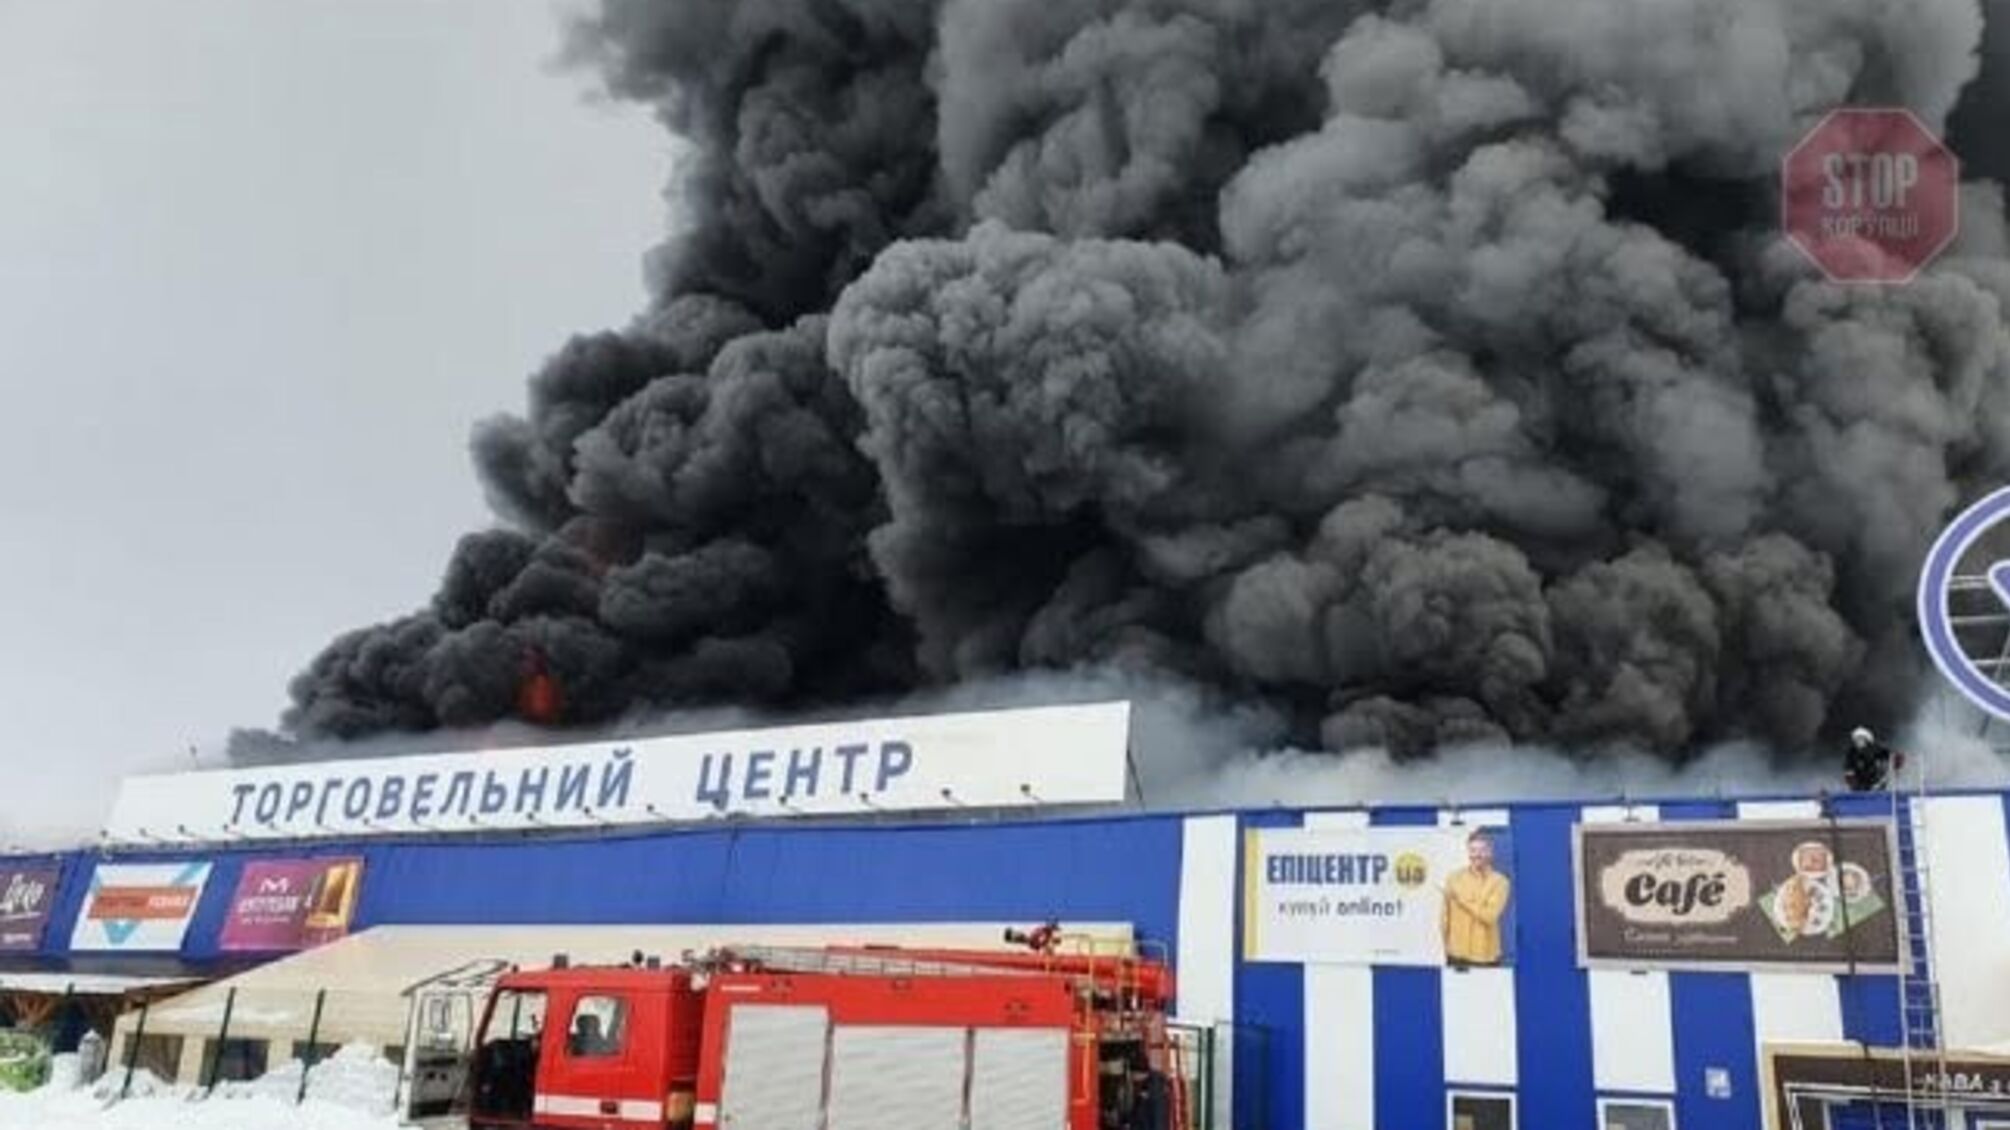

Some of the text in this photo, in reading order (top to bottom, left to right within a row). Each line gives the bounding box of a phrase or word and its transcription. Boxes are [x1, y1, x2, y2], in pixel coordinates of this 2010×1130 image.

[231, 740, 913, 826] ТОРГОВЕЛЬНИЙ ЦЕНТР
[1267, 854, 1388, 886] ЕПІЦЕНТР
[1624, 872, 1726, 915] Café
